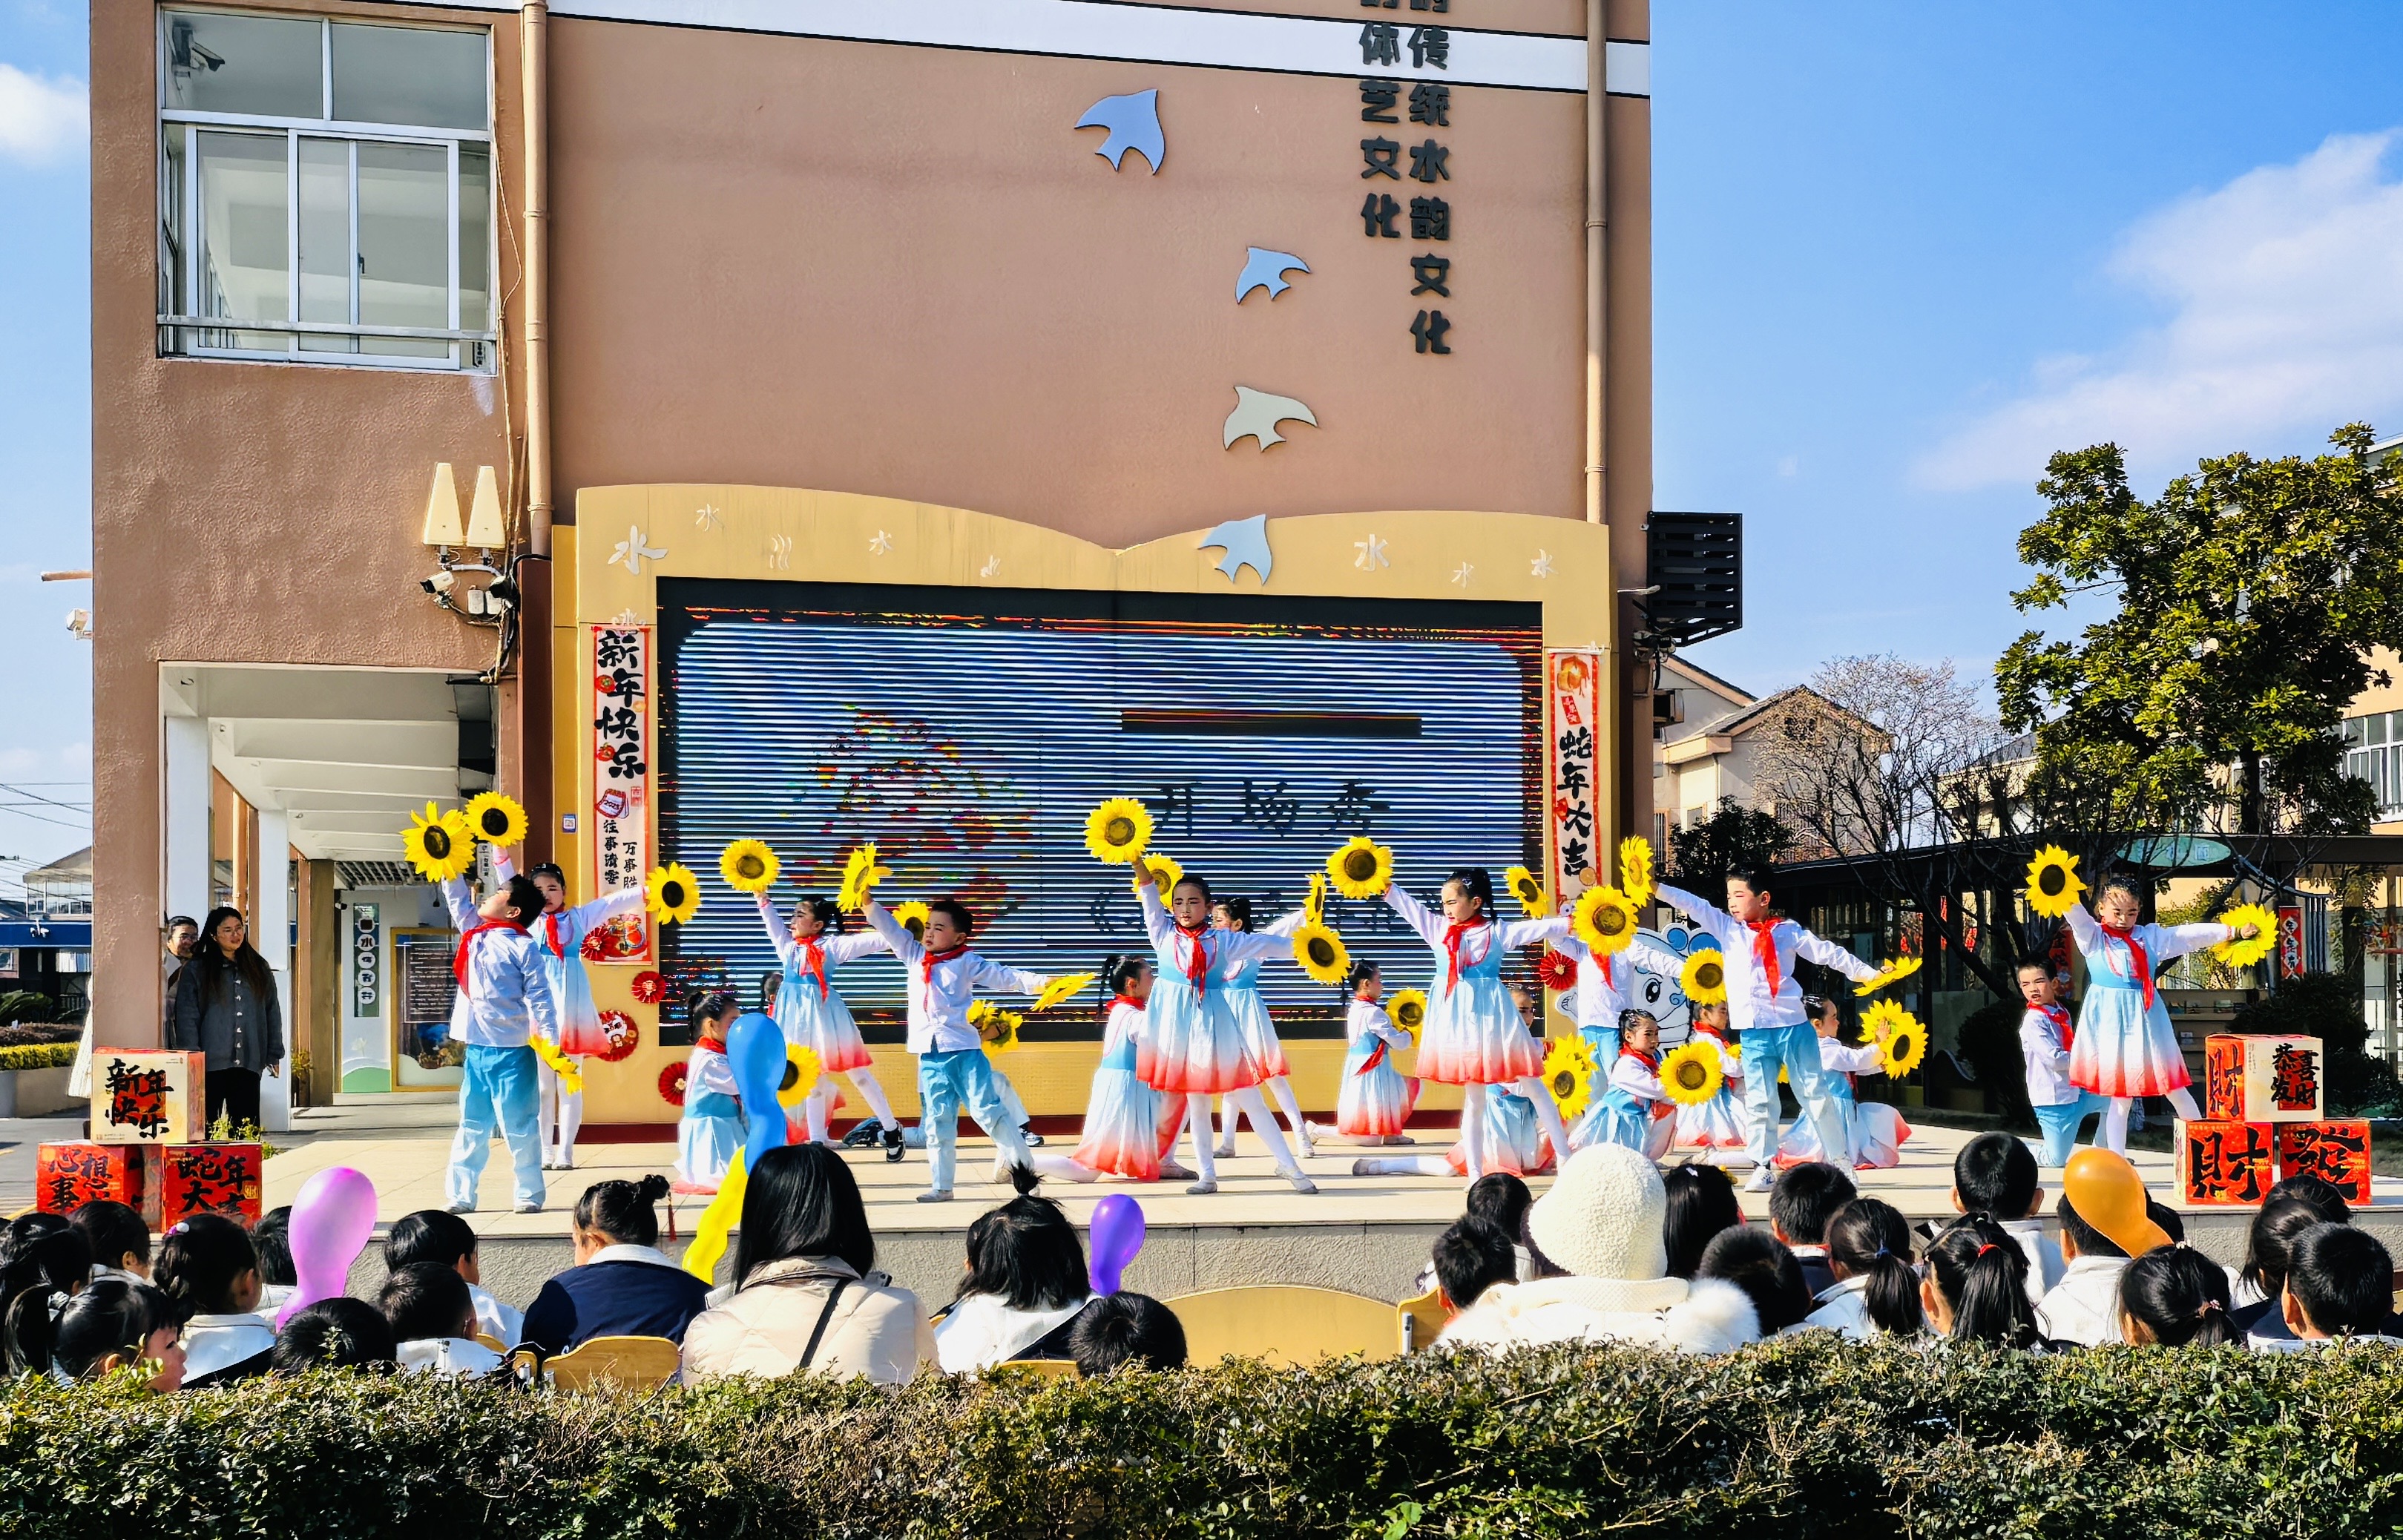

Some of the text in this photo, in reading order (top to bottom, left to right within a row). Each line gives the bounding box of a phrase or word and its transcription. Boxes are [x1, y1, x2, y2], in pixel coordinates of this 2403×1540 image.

[1359, 0, 1400, 238] 体艺文化
[1407, 0, 1451, 355] 传统水韵文化
[594, 630, 645, 779] 新年快乐
[1556, 726, 1593, 877] 蛇年大吉
[105, 1058, 174, 1102] 新年
[105, 1097, 170, 1139] 快乐
[49, 1148, 113, 1189] 心想
[177, 1147, 255, 1191] 蛇年
